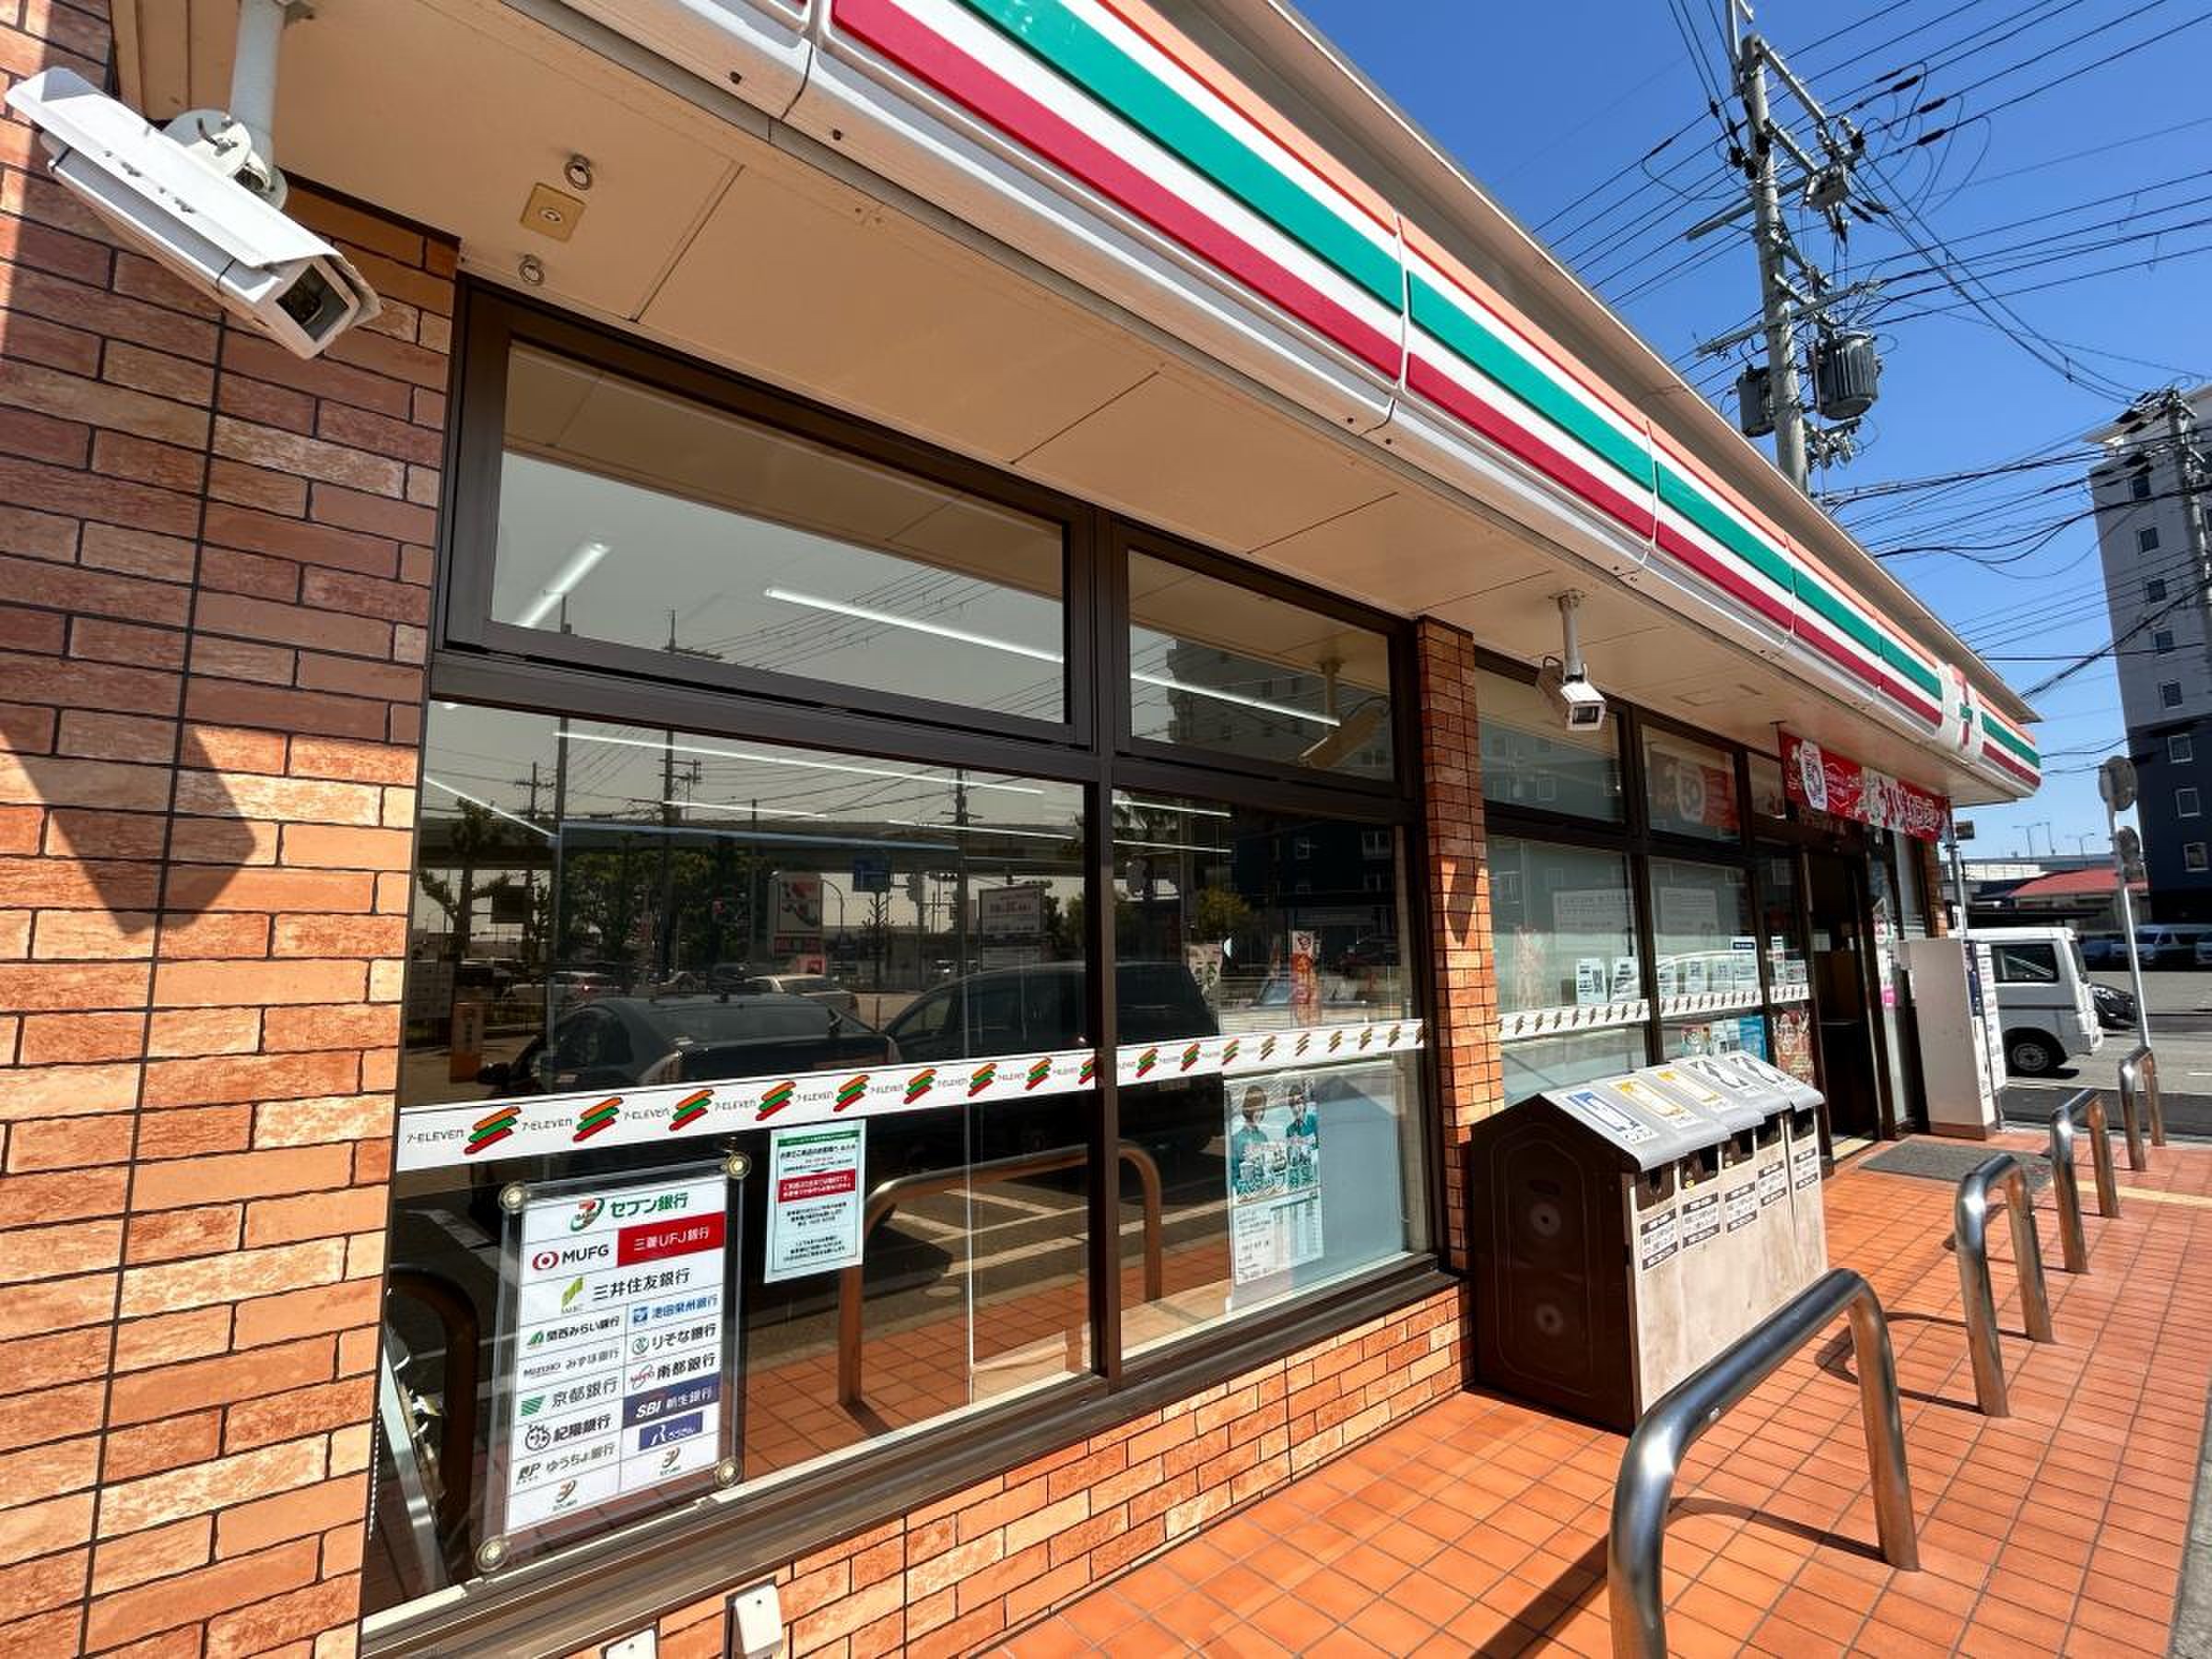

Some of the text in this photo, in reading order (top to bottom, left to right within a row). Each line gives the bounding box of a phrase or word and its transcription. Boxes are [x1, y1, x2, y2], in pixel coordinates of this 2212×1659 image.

[611, 1192, 688, 1218] セブン銀行
[633, 1227, 709, 1252] 三菱UFJ銀行
[561, 1244, 609, 1264] MUFG
[592, 1268, 691, 1301] 三井住友銀行
[546, 1316, 620, 1342] 関西みらい銀行
[652, 1323, 716, 1348] りそな銀行
[657, 1352, 715, 1380] 南都銀行
[552, 1377, 618, 1407] 京都銀行
[636, 1401, 662, 1418] SBI
[554, 1414, 611, 1441] 紀陽銀行
[547, 1443, 615, 1473] ゆうちょ銀行
